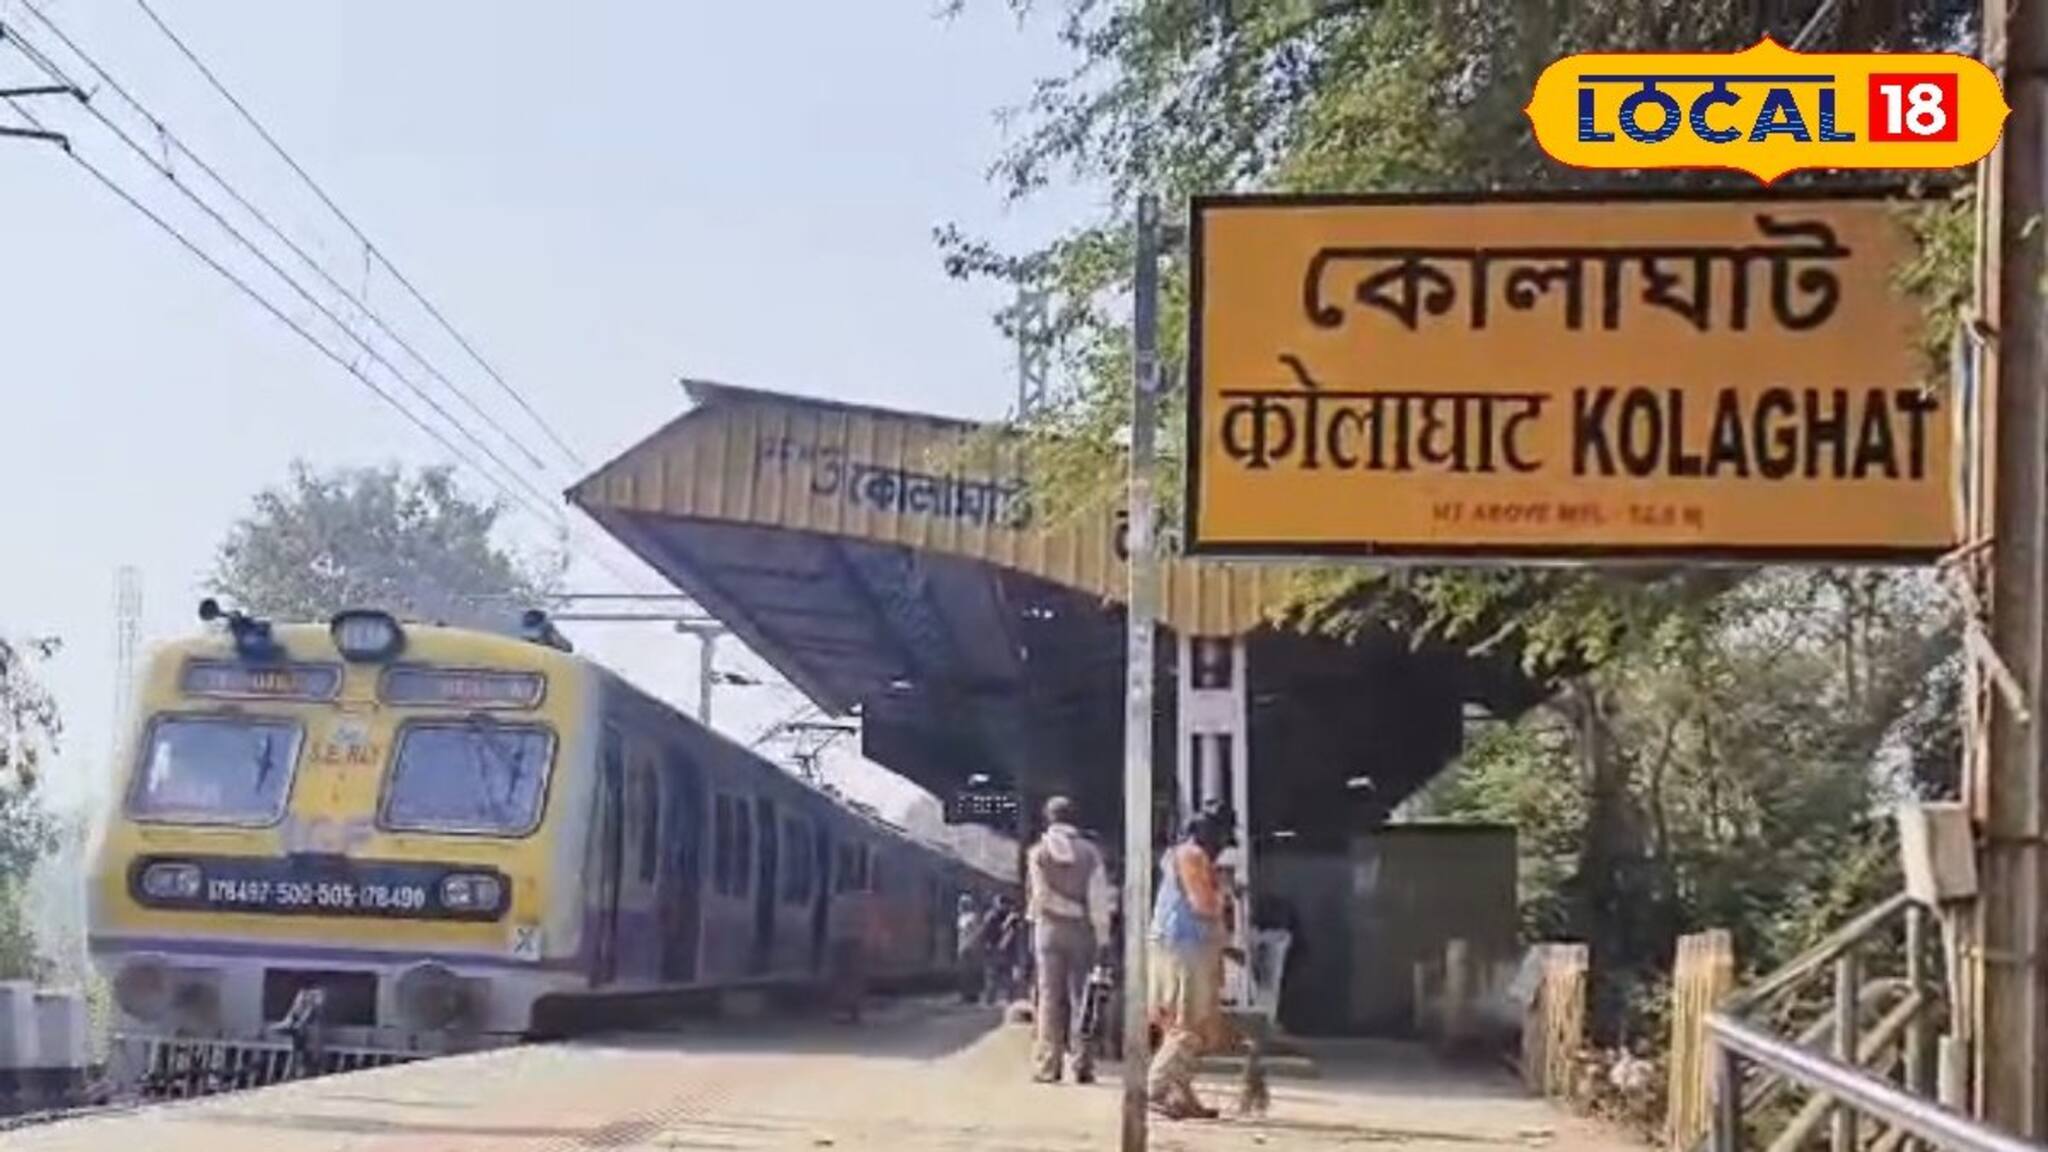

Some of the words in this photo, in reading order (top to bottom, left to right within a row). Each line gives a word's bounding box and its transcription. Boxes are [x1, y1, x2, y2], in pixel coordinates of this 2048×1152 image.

[1302, 213, 1852, 333] কোলাঘাট
[1219, 354, 1553, 476] कोलाघाट
[1571, 386, 1940, 481] KOLAGHAT
